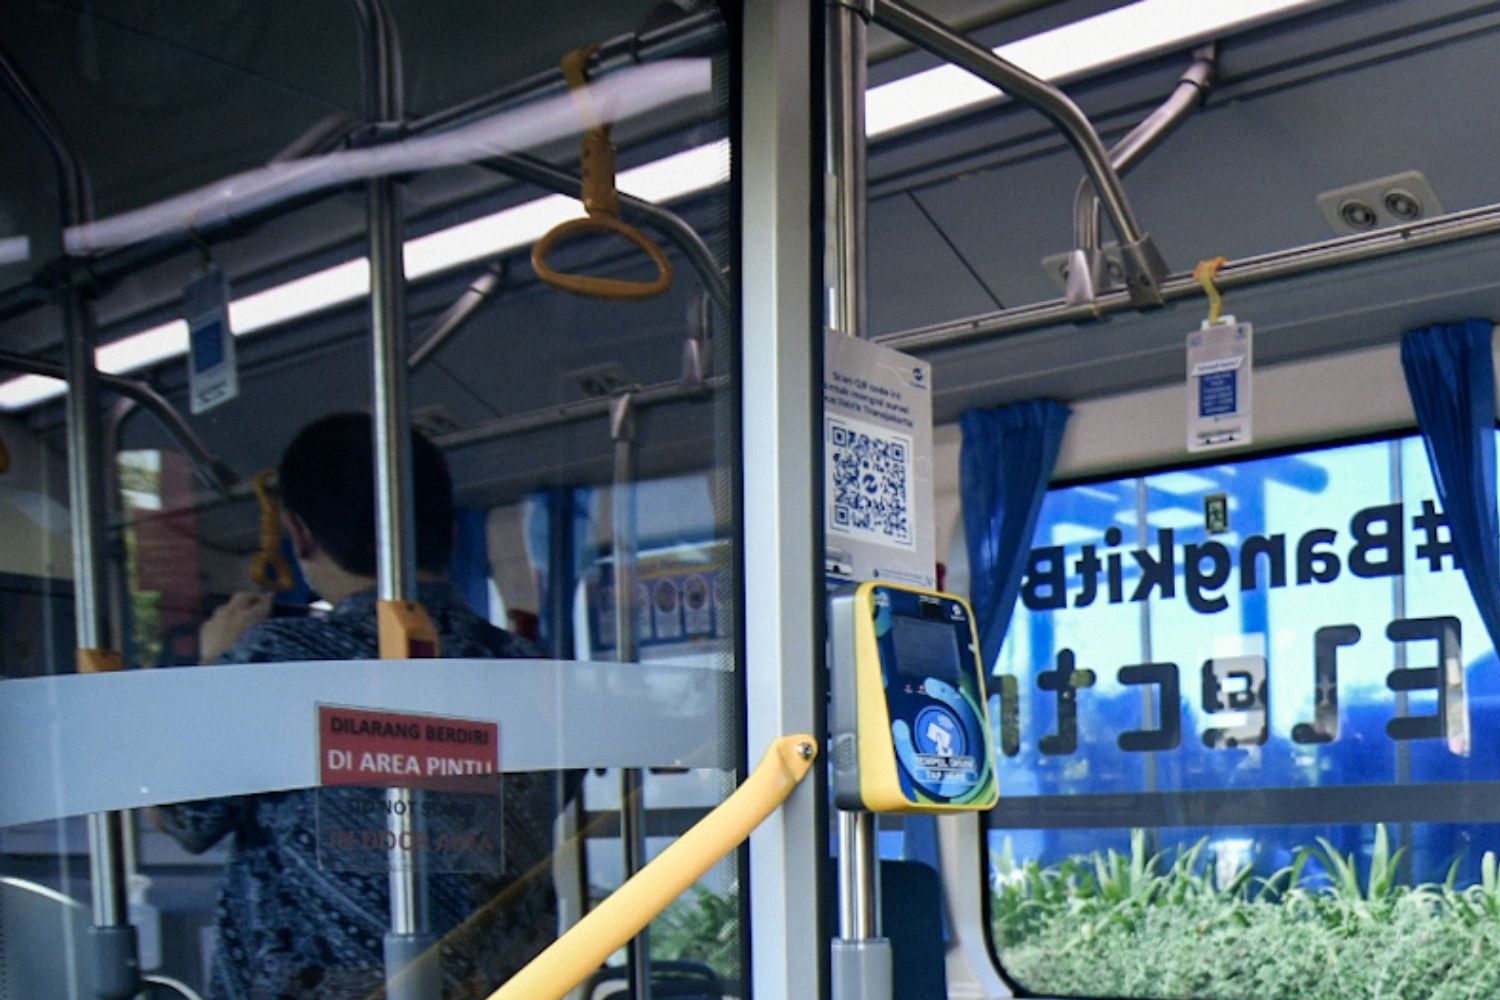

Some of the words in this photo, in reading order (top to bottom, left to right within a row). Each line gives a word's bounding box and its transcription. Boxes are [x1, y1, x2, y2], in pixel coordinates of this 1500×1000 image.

[329, 715, 421, 741] DILARANG
[425, 724, 490, 745] BERDIRI
[327, 748, 353, 770] DI
[359, 751, 421, 775] AREA
[426, 755, 493, 777] PINTU
